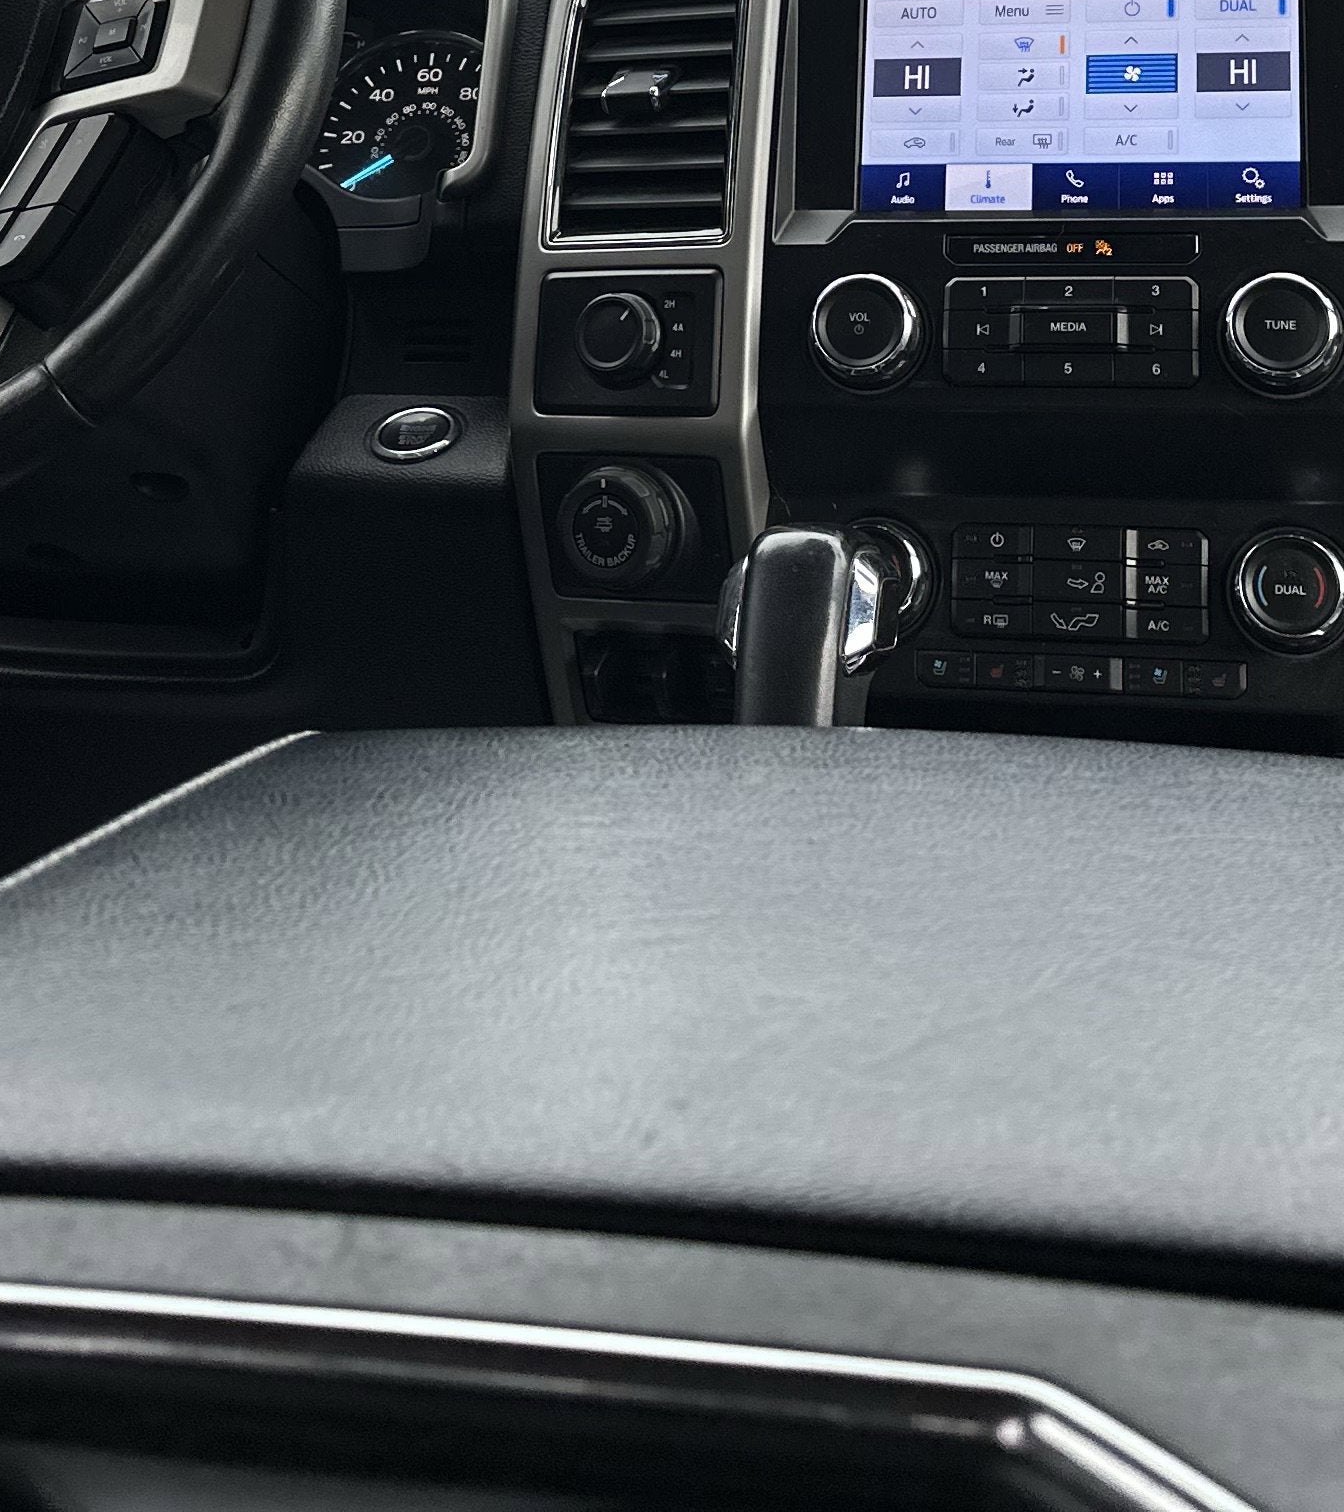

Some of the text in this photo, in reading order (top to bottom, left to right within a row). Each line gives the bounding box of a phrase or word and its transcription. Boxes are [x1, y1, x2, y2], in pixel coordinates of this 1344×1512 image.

[994, 5, 1030, 18] Menu
[1219, 0, 1257, 13] DUAL
[900, 6, 937, 20] AUTO
[416, 68, 443, 83] 60
[903, 64, 931, 90] HI
[1228, 59, 1257, 86] HI
[369, 88, 395, 102] 40
[416, 87, 440, 96] MPH
[385, 112, 400, 126] 60
[340, 130, 365, 145] 20
[994, 137, 1016, 147] Rear
[1114, 134, 1138, 147] A/C
[890, 194, 916, 205] Audio
[970, 194, 1006, 205] Climate
[1060, 194, 1089, 204] Phone
[1151, 193, 1175, 205] Apps
[1234, 193, 1273, 205] Settings
[973, 242, 1084, 254] PASSENGER AIRBAG OFF
[980, 286, 988, 297] 1
[1064, 286, 1074, 297] 2
[1151, 285, 1160, 297] 3
[663, 300, 676, 310] 2H
[849, 313, 870, 323] VOL
[1050, 321, 1087, 332] MEDIA
[1264, 320, 1297, 331] TUNE
[669, 349, 683, 359] 4H
[658, 369, 670, 379] 4L
[977, 362, 986, 374] 4
[1064, 362, 1073, 374] 5
[1152, 364, 1161, 376] 6
[574, 531, 637, 567] TRAILER BACKUP
[985, 571, 1009, 581] MAX
[1145, 576, 1170, 586] MAX
[1147, 584, 1168, 595] A/C
[1274, 583, 1307, 596] DUAL
[1147, 620, 1171, 632] A/C
